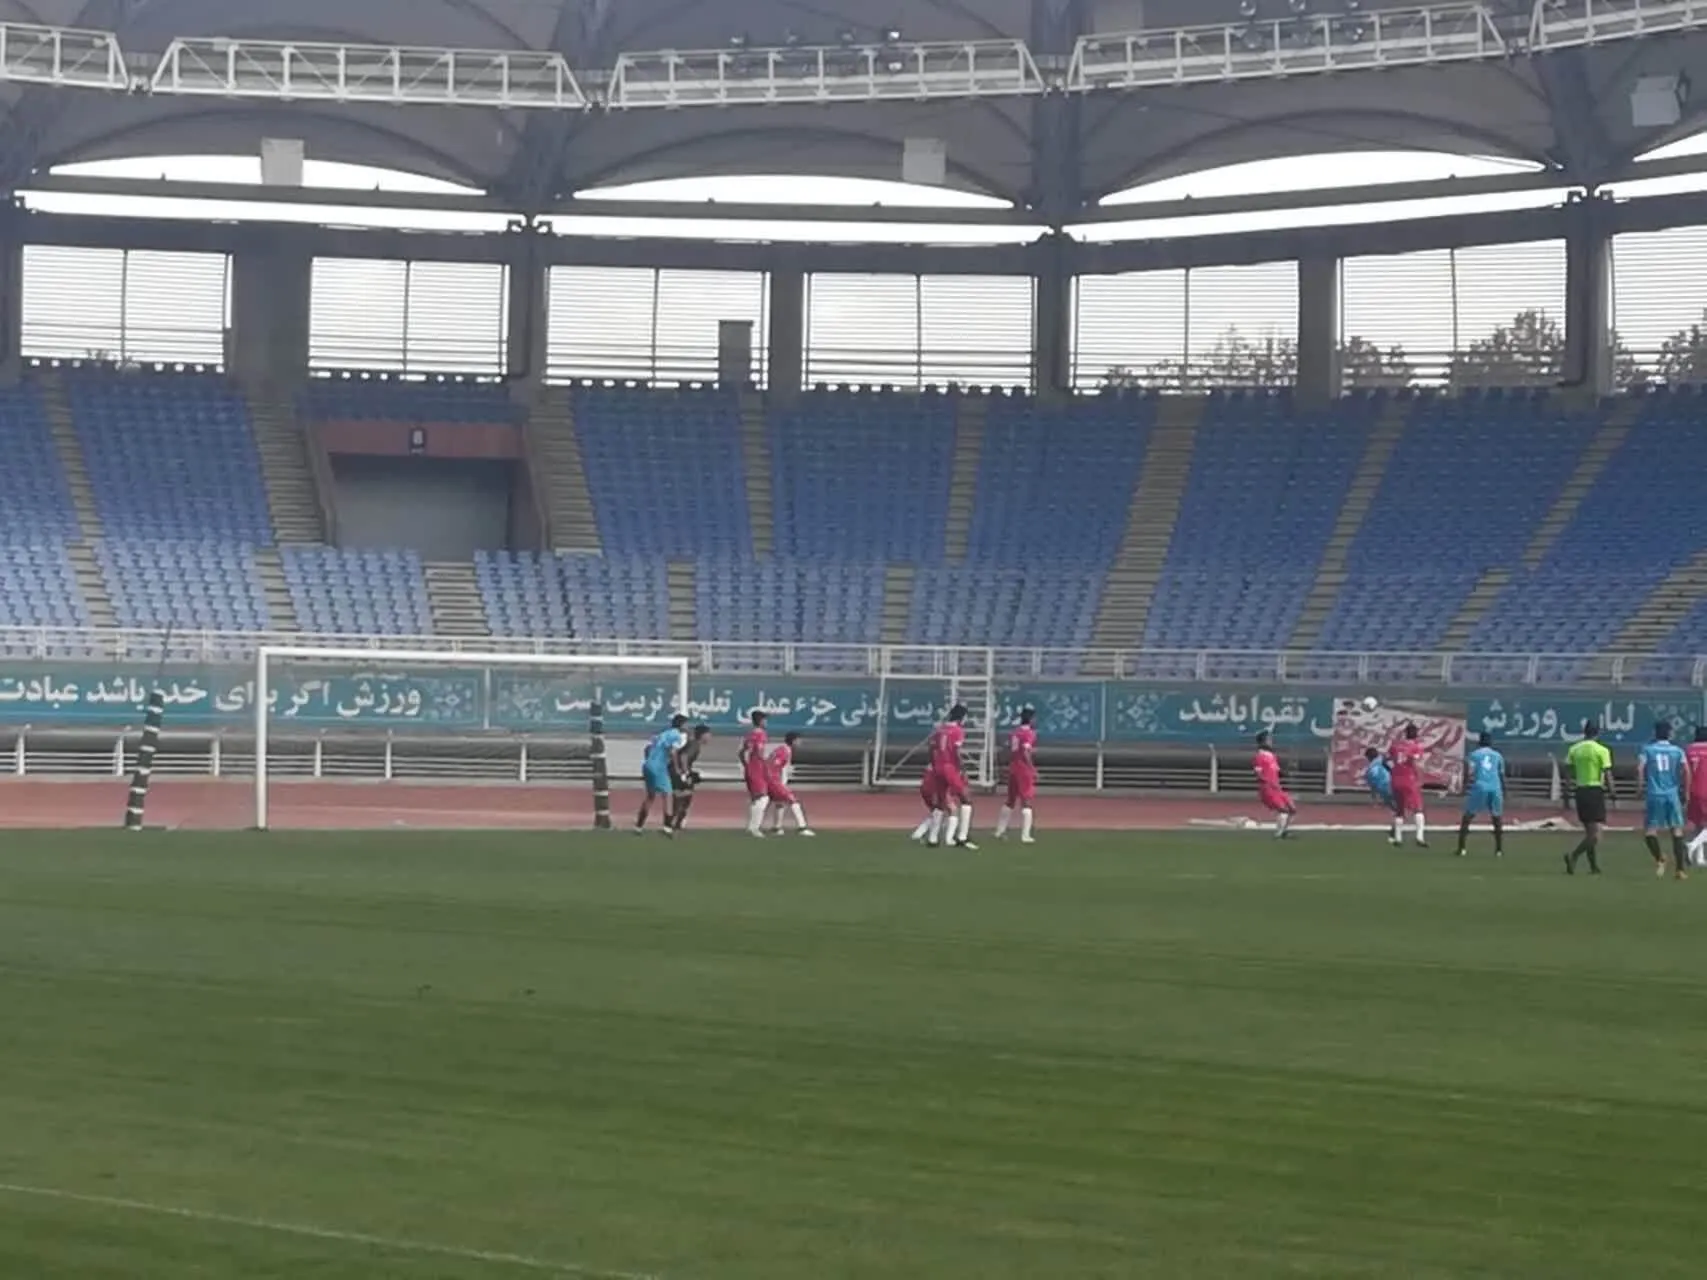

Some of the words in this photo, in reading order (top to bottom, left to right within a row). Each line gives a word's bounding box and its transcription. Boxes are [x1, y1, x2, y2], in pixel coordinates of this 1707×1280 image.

[0, 675, 79, 709] عبادت
[86, 676, 146, 711] باشد
[214, 680, 279, 712] بای
[336, 680, 422, 716] ورزش
[605, 688, 665, 721] تربیت
[736, 690, 792, 725] عملی
[795, 695, 837, 726] جزء
[1179, 693, 1248, 732] باشد
